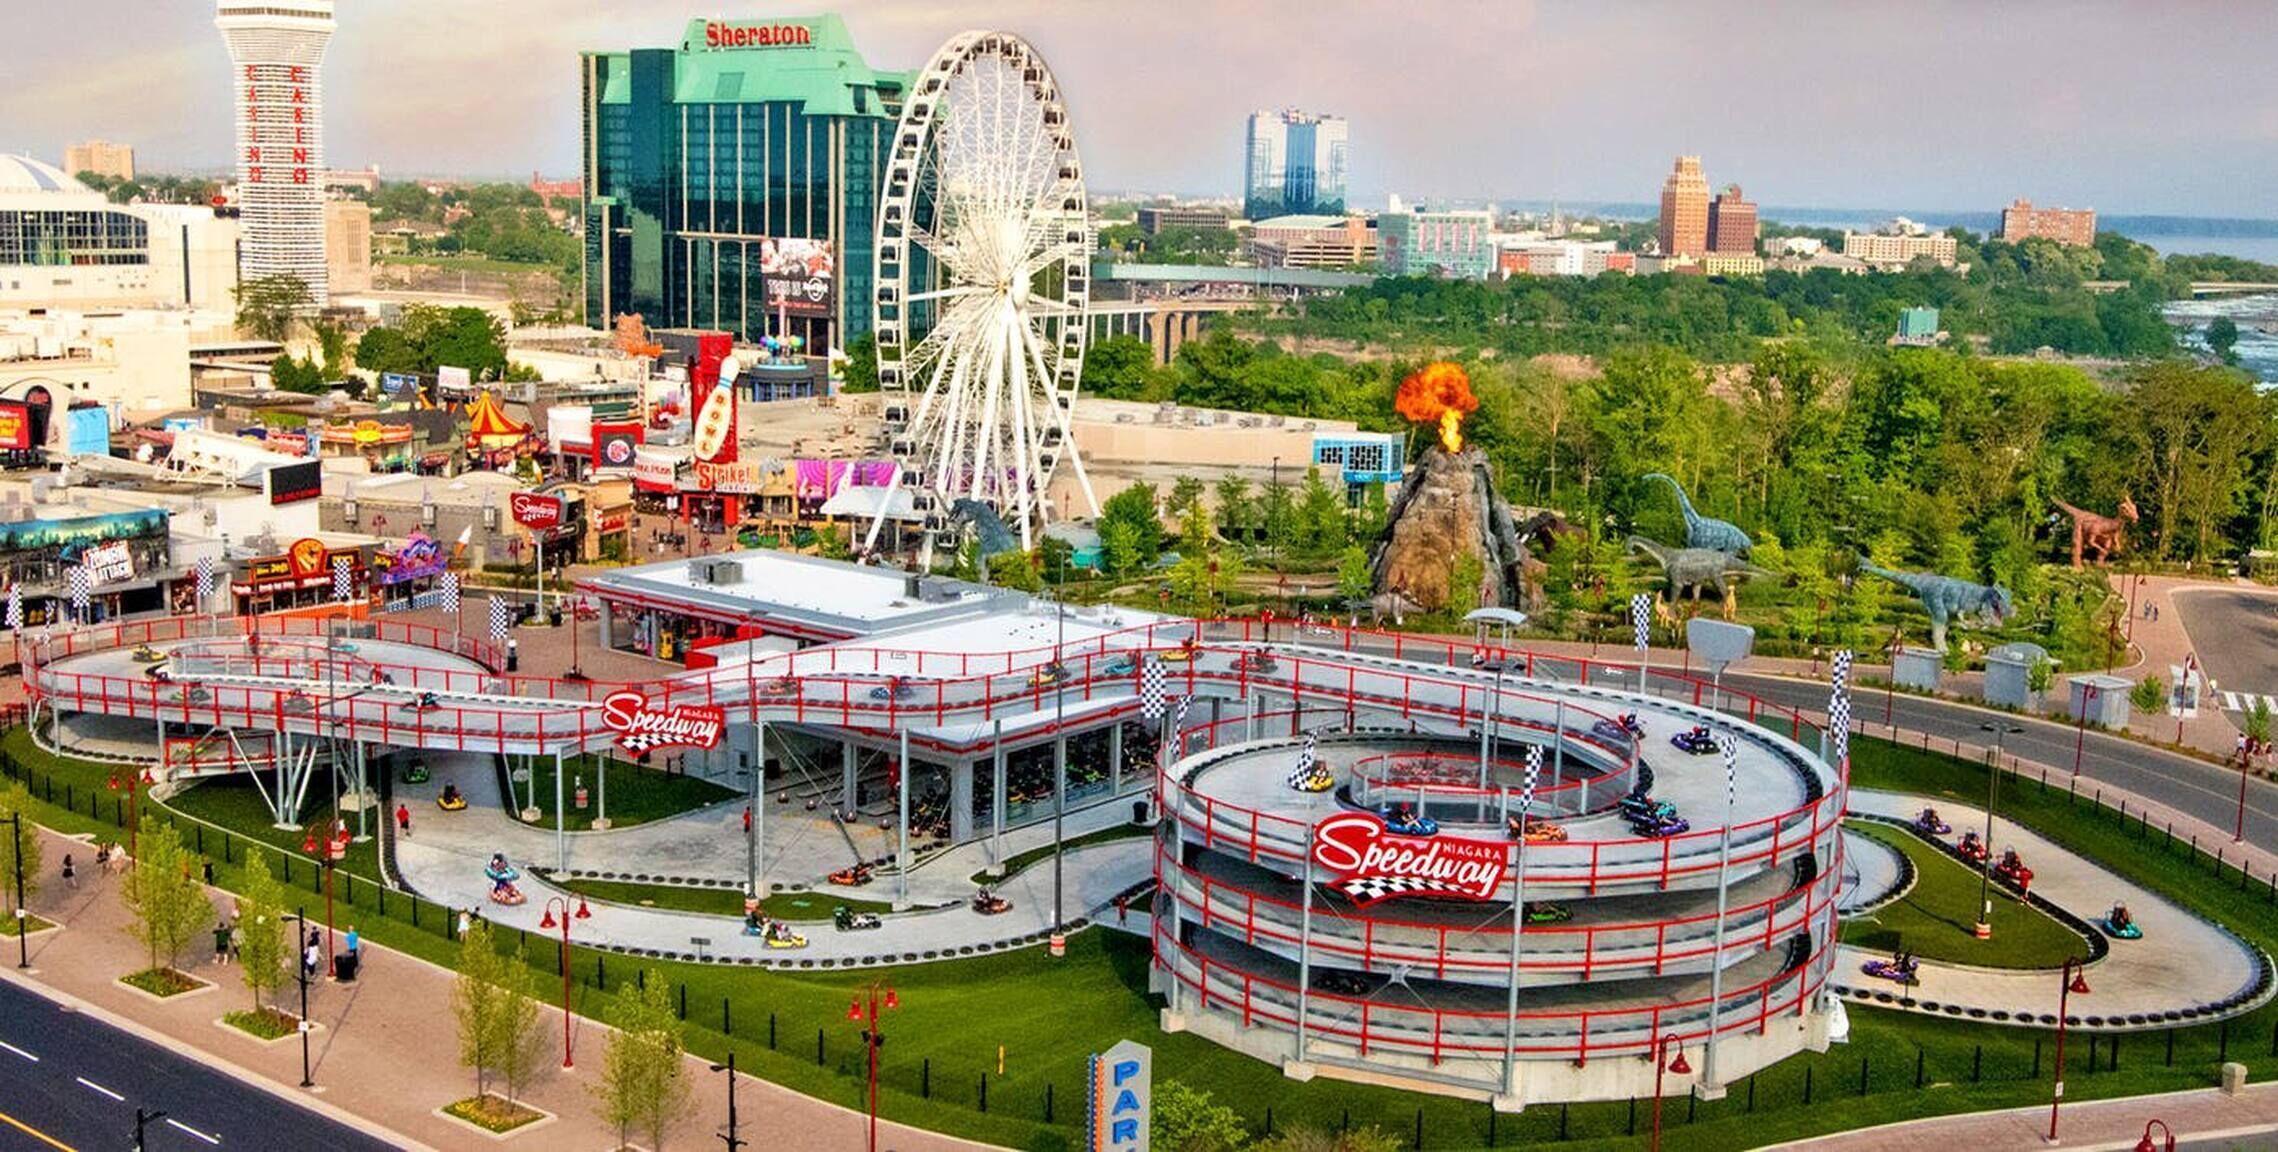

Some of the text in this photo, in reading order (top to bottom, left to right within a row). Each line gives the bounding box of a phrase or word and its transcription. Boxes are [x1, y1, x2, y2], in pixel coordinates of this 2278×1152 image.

[705, 22, 810, 47] Sheraton
[290, 65, 308, 185] CASINO
[701, 394, 725, 452] BOWL
[603, 693, 718, 747] Speedway
[1315, 818, 1501, 897] Speedway
[1443, 843, 1502, 861] NIAGARA
[1111, 1061, 1141, 1152] PAR
